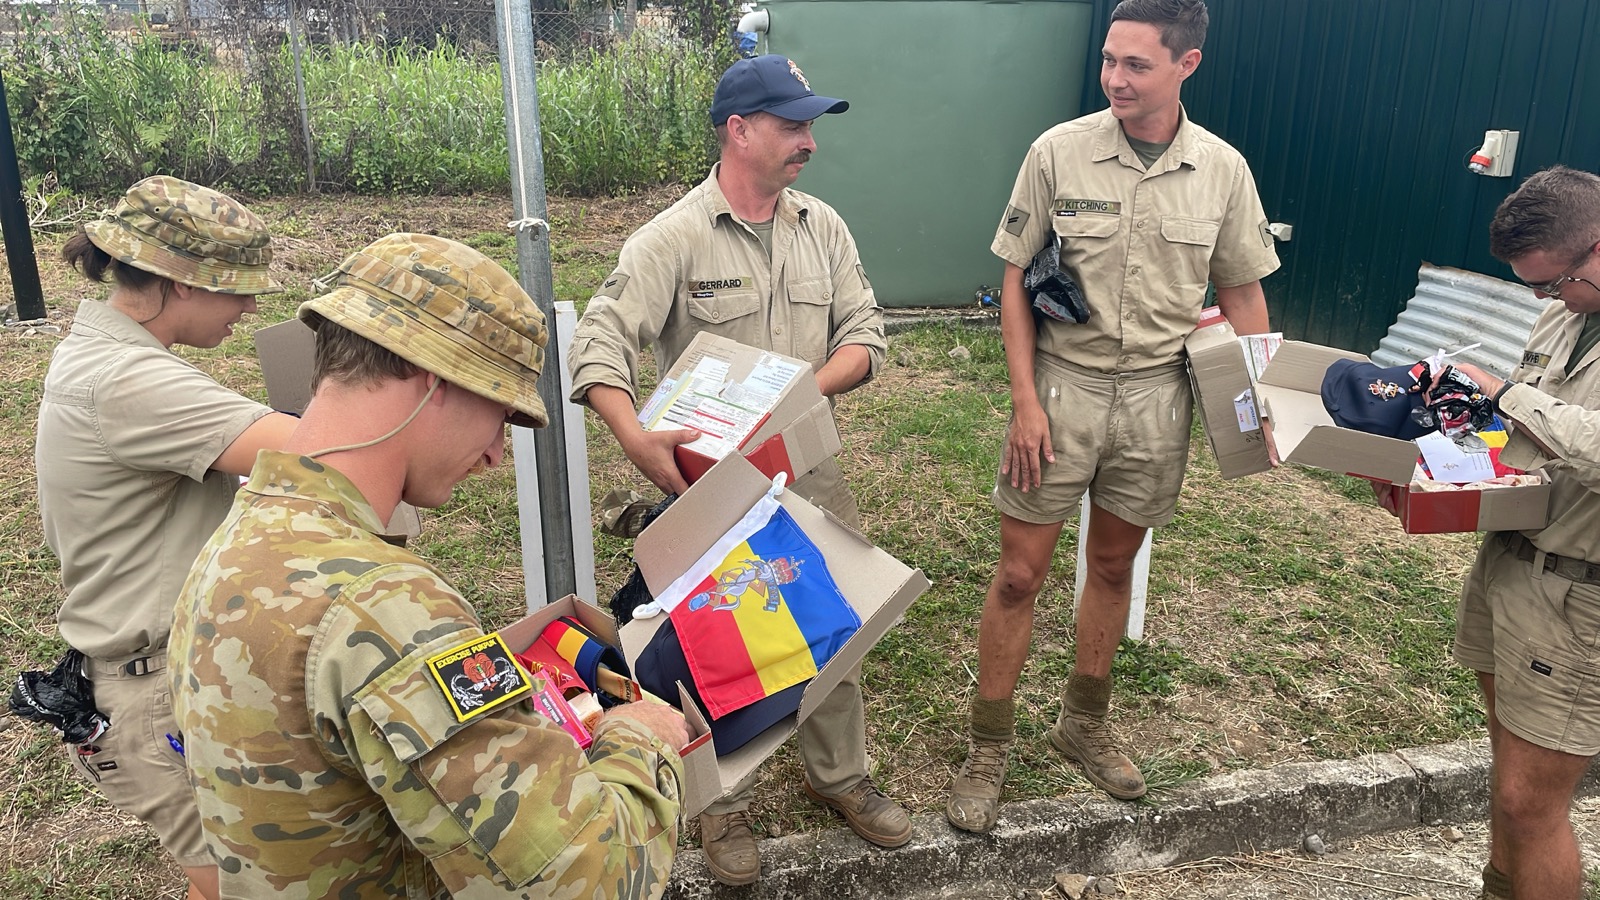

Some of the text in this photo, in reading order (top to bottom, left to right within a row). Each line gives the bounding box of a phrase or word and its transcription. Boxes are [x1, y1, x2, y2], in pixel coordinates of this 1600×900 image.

[1065, 201, 1108, 211] KITCHING
[698, 279, 742, 290] GERRARD
[436, 639, 497, 670] EXERCISE PUKPUK
